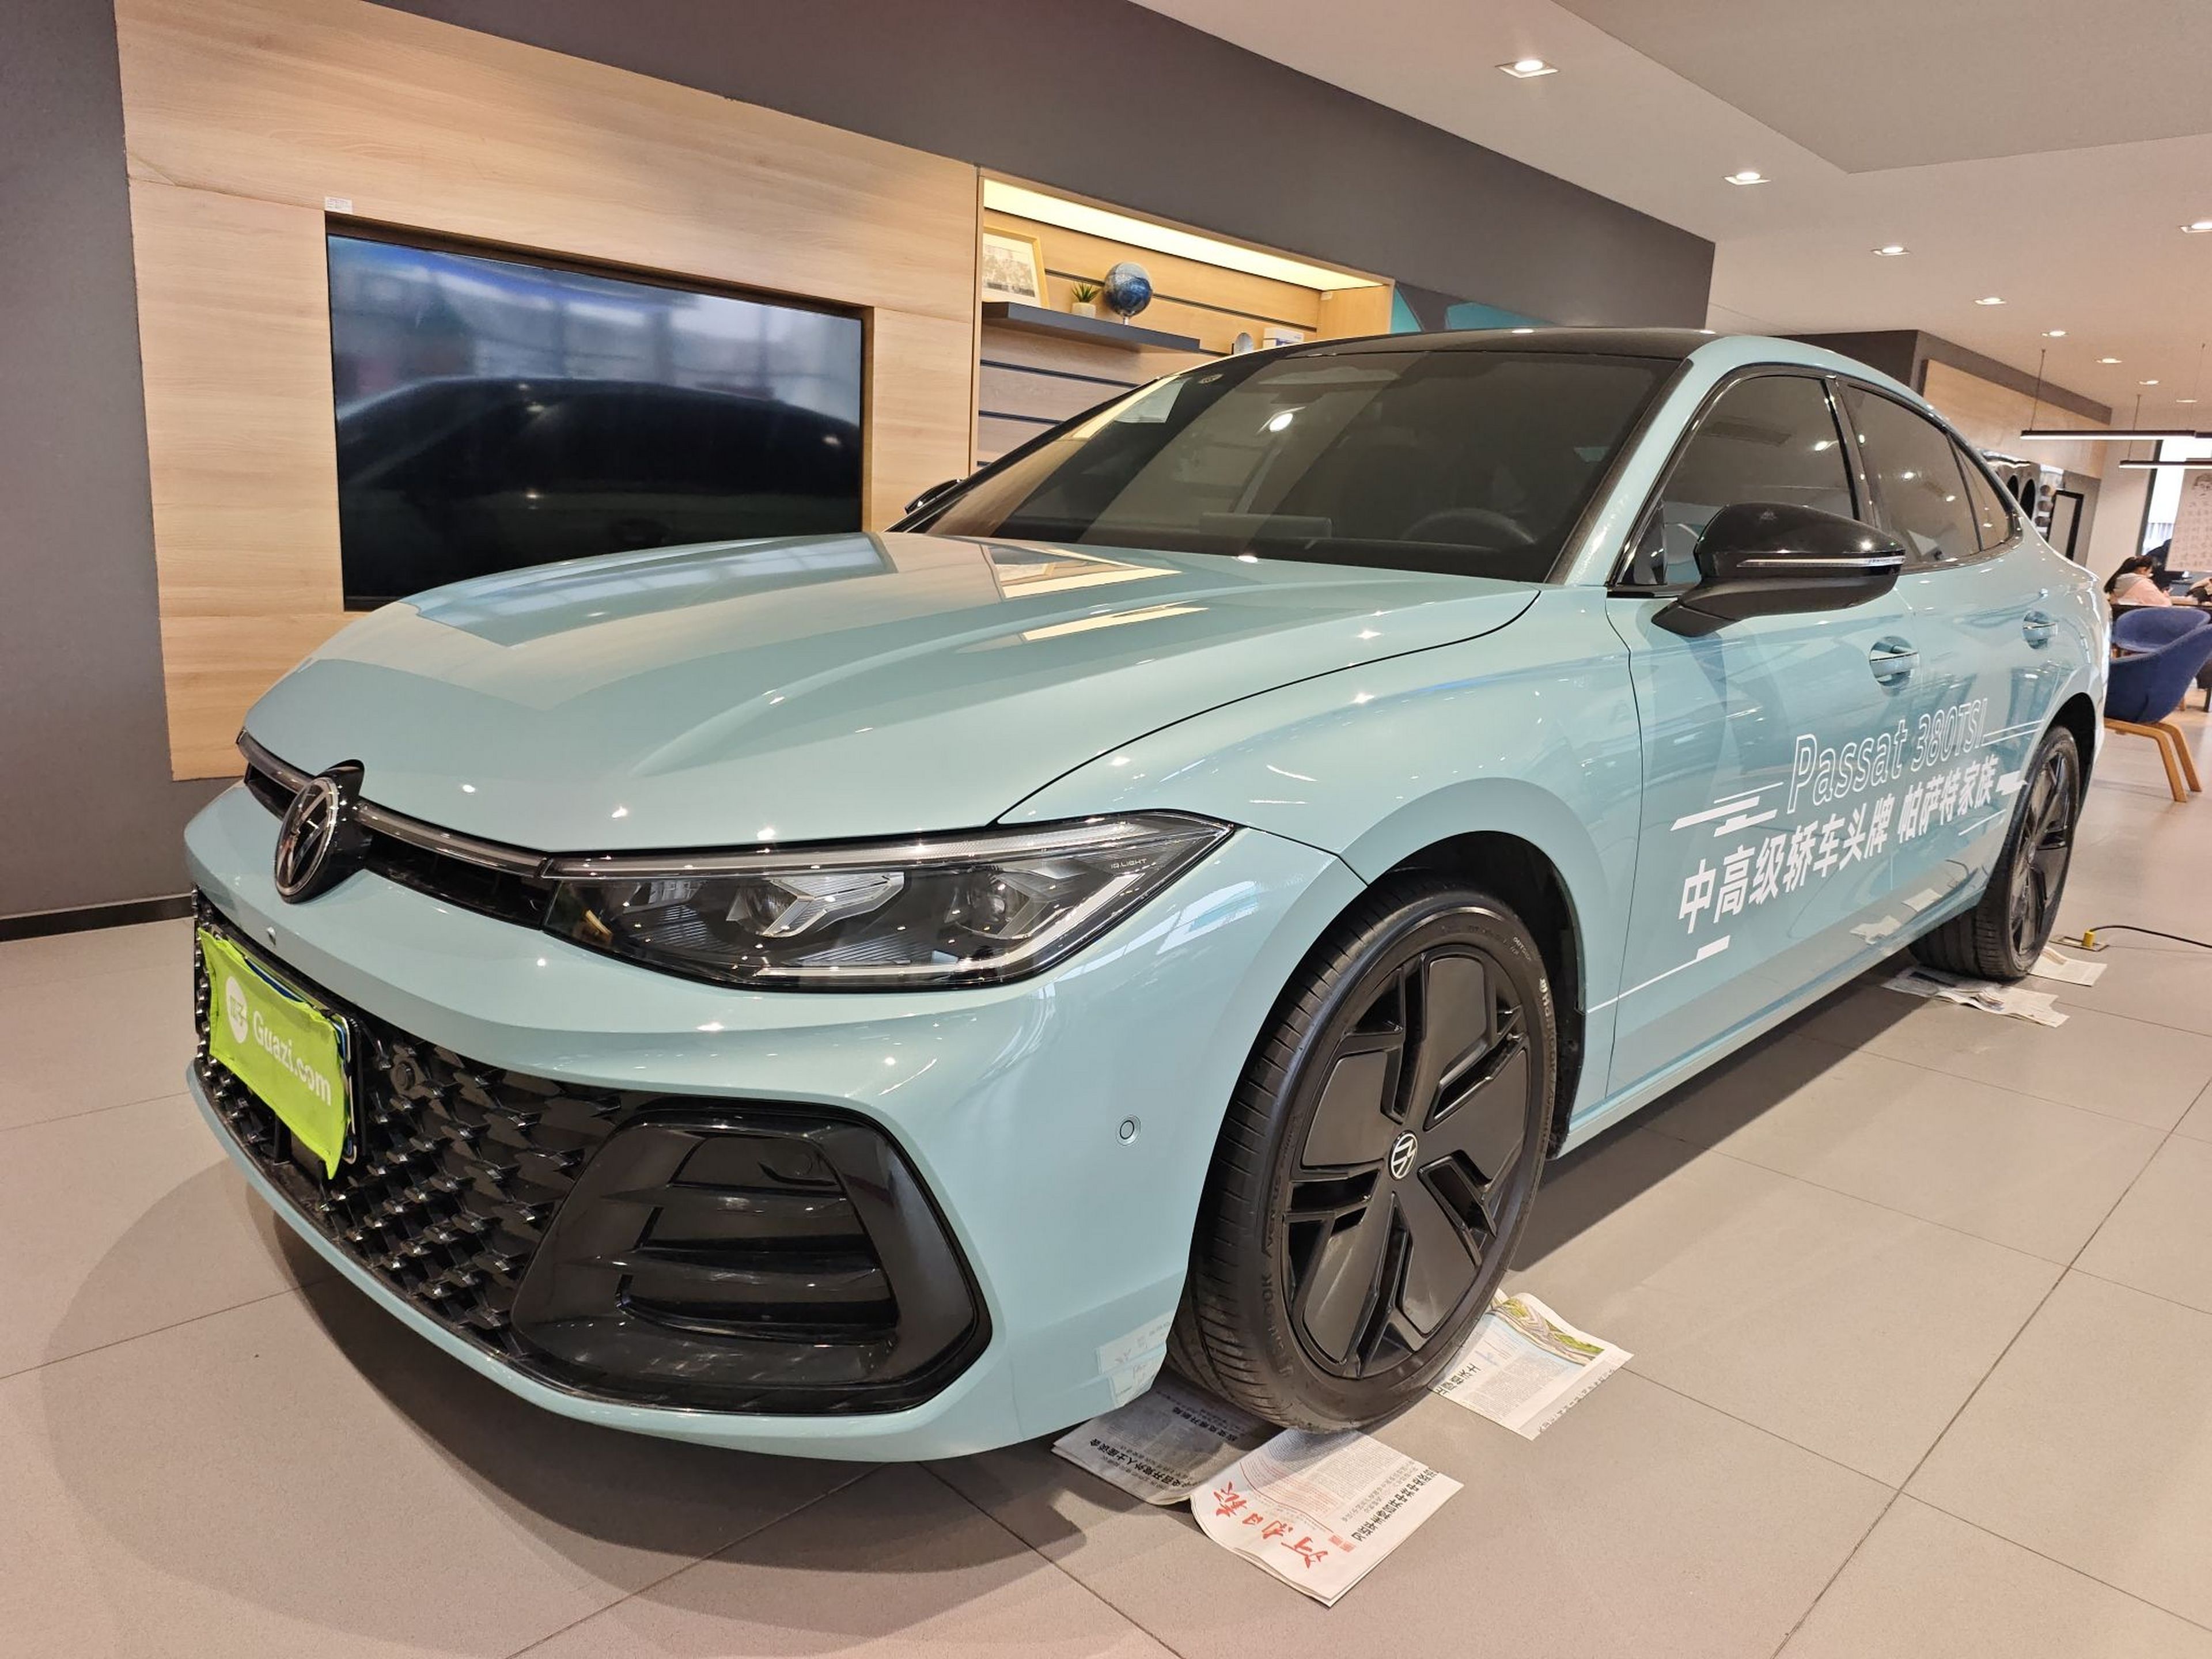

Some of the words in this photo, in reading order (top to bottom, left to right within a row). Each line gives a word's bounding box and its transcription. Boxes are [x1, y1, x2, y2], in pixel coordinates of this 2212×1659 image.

[1787, 718, 1908, 815] Passat
[1911, 698, 1988, 772] 380TSI
[1677, 793, 1896, 934] 中高级轿车头牌
[1896, 753, 1999, 844] 帕萨特家族
[252, 1010, 332, 1107] Guazi.com
[1351, 1468, 1440, 1542] 习近平主持召开中共中央政治
